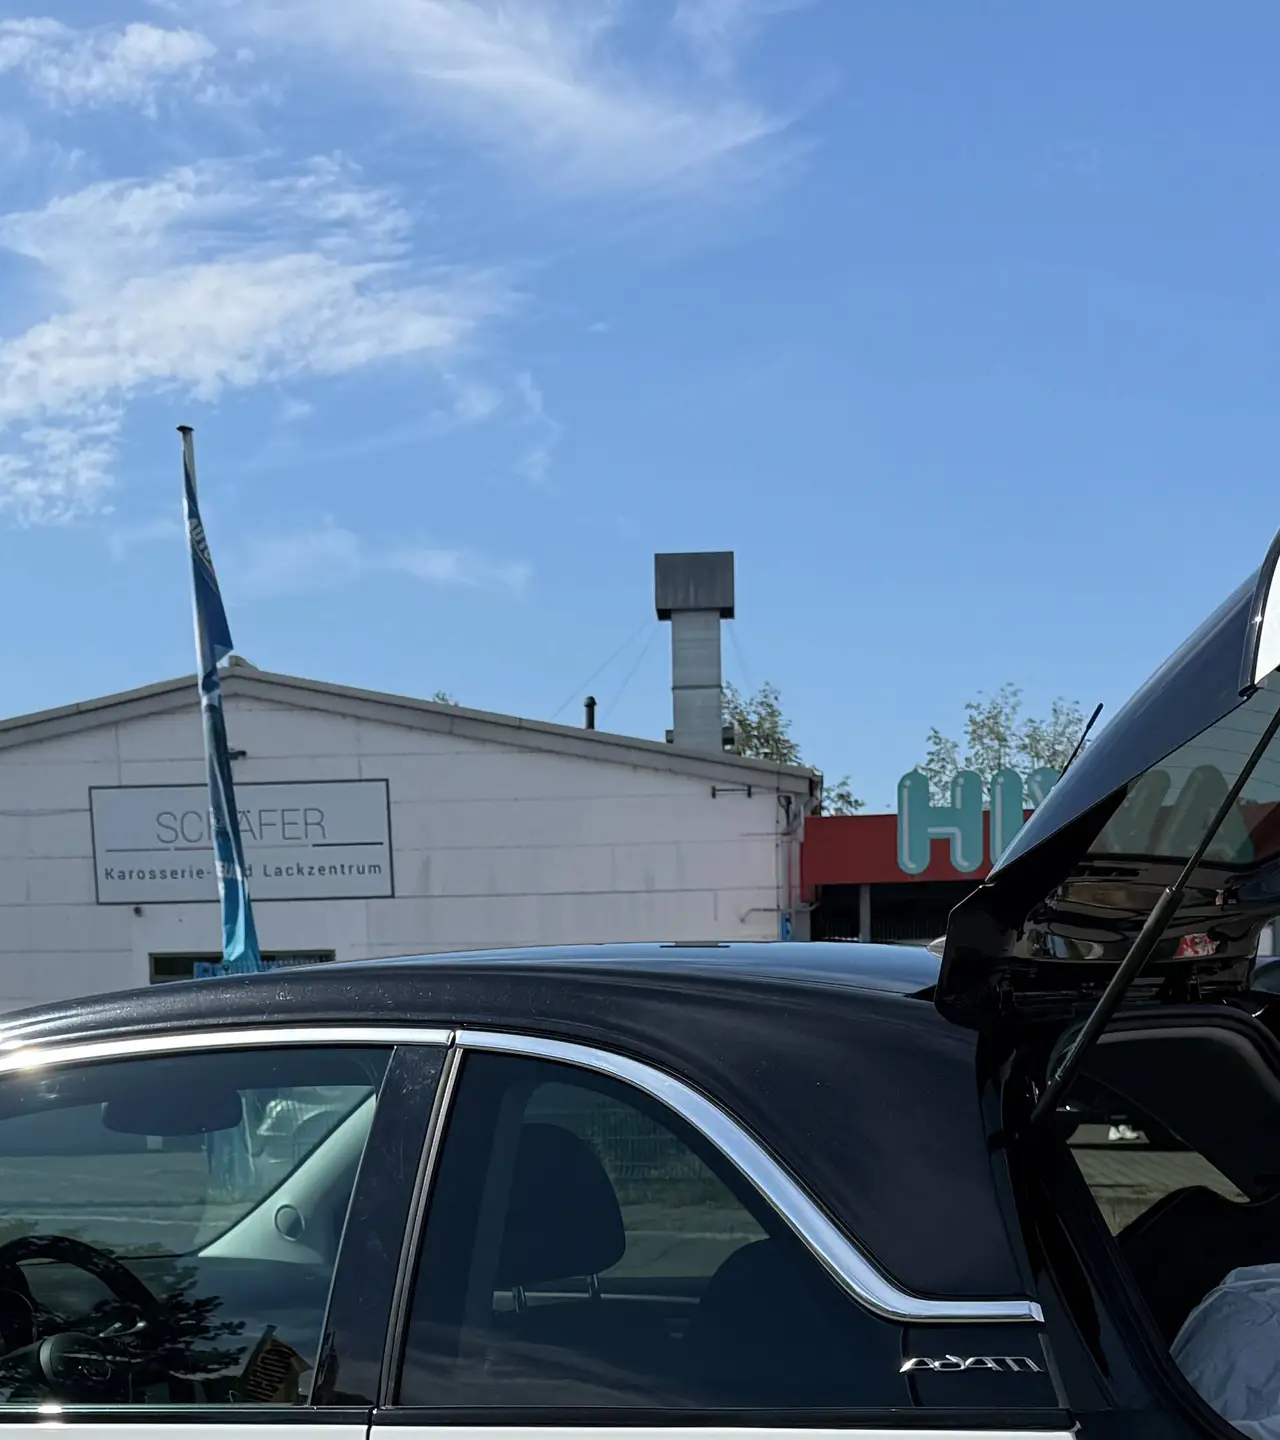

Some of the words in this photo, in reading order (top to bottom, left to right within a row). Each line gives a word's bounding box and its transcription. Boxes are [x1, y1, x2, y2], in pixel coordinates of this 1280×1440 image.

[104, 866, 212, 881] Karosserie-
[262, 862, 382, 878] Lackzentrum
[899, 1354, 1045, 1373] ADAM
